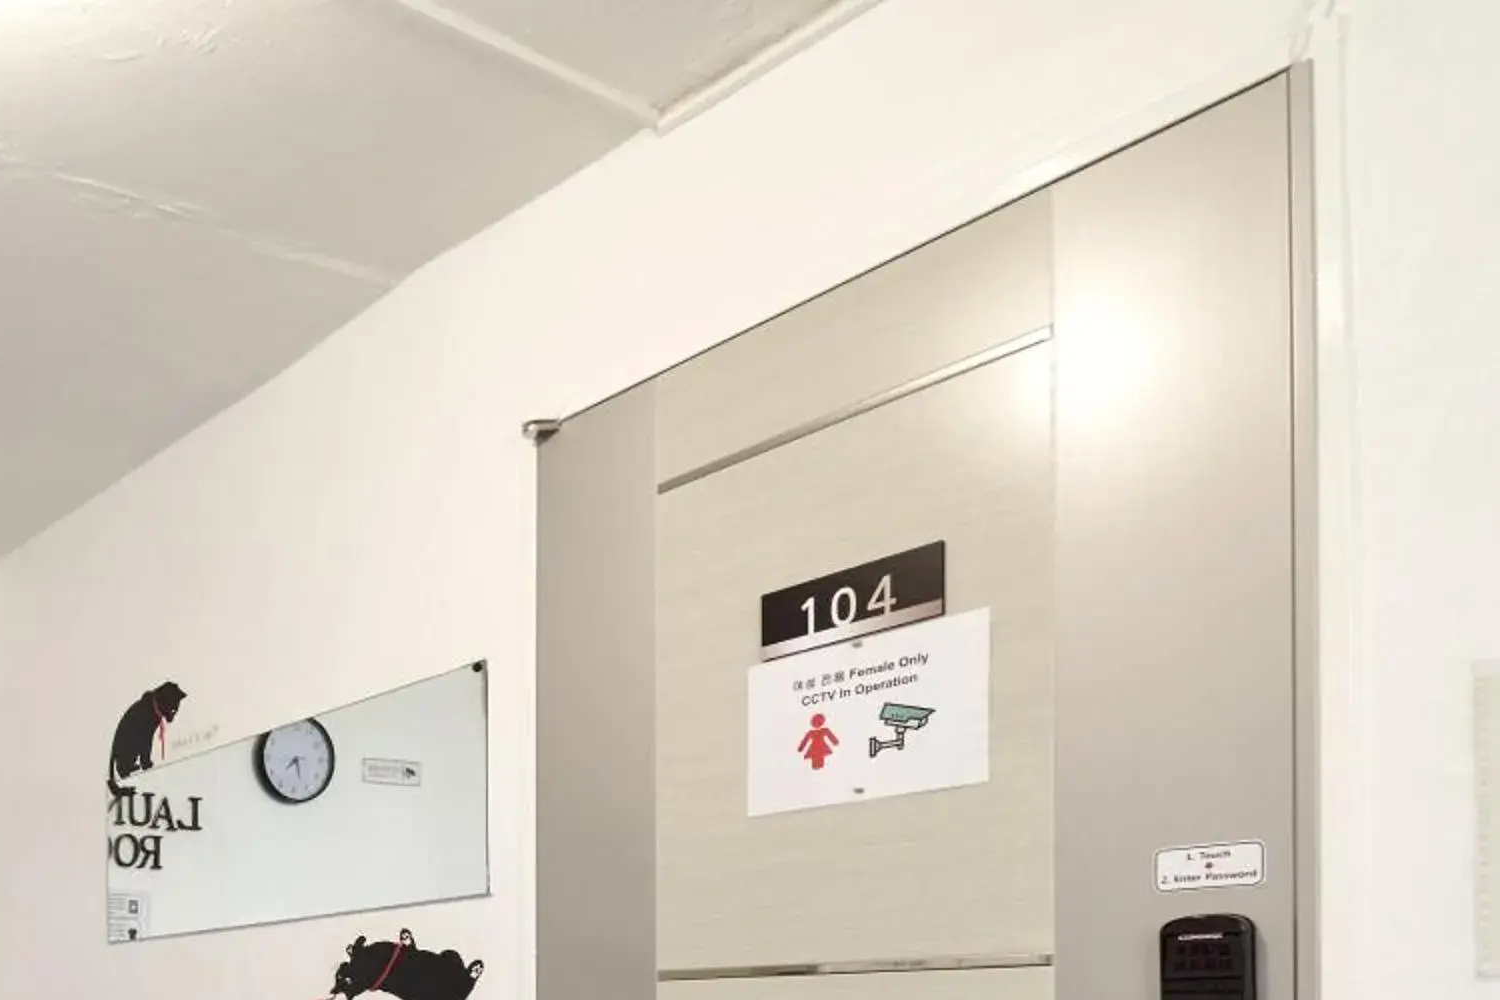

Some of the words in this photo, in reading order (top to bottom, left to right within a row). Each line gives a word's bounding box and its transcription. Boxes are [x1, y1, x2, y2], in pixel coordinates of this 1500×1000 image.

[801, 574, 897, 638] 104
[849, 660, 895, 679] Female
[899, 652, 929, 669] Only
[801, 690, 836, 707] CCTV
[855, 673, 919, 695] Operation
[1200, 850, 1231, 859] Touch
[1174, 873, 1201, 883] Enter
[1205, 869, 1257, 881] Password
